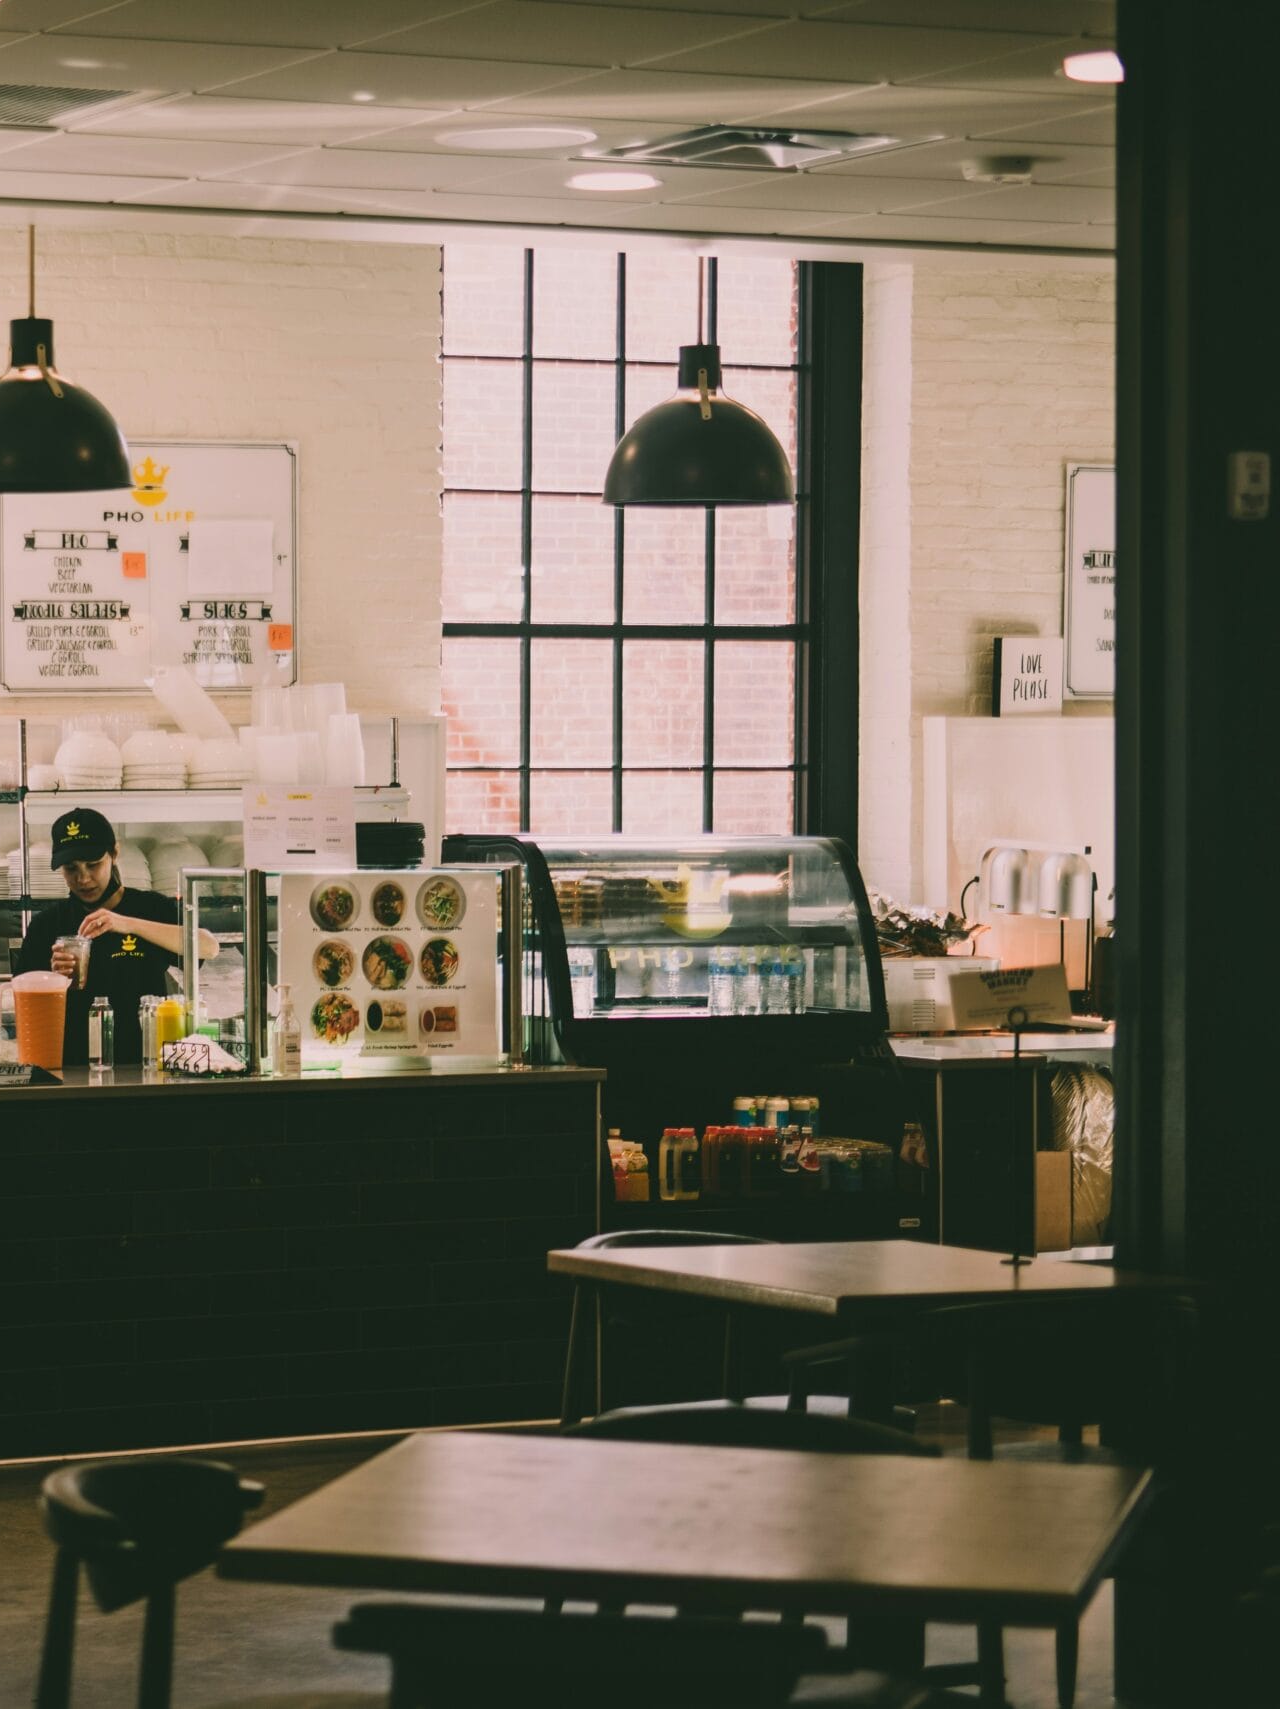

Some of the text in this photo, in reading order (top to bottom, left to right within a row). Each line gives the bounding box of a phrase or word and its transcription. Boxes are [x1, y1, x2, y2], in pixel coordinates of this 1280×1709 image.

[103, 511, 194, 523] PHO LIFE
[53, 556, 82, 567] CHICKEN
[57, 569, 76, 580] BEEF
[48, 582, 93, 593] VEGETARIAN
[1021, 653, 1042, 674] LOVE
[607, 946, 694, 969] PHO
